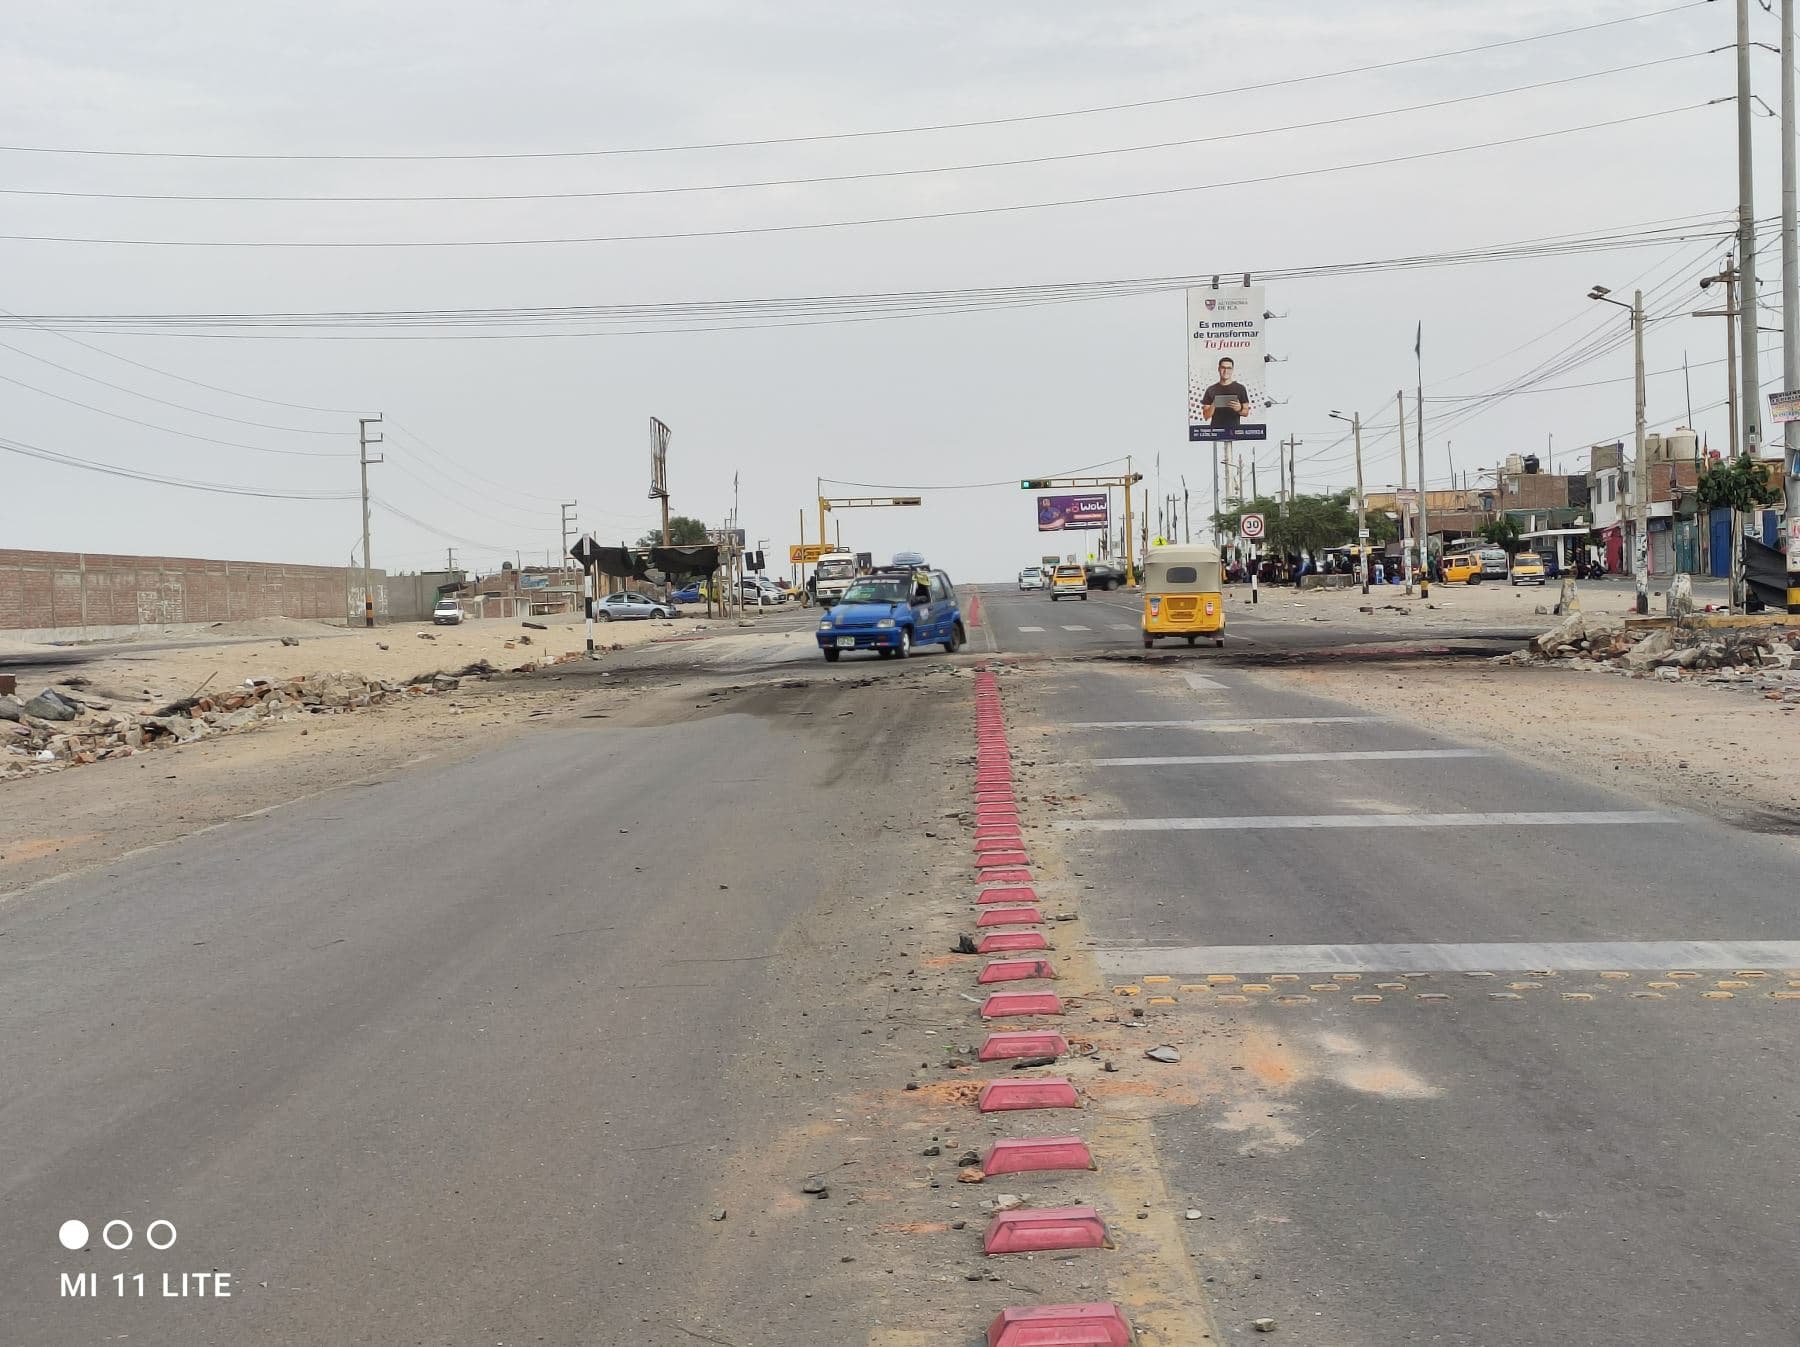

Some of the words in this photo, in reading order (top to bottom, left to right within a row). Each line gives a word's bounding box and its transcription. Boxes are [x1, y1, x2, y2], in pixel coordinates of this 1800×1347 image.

[1199, 321, 1210, 329] Es
[1211, 320, 1254, 328] momento
[1193, 331, 1205, 339] de
[1207, 330, 1259, 338] transformar
[1204, 340, 1217, 349] Tu
[1218, 339, 1251, 350] futuro
[1246, 519, 1260, 529] 30
